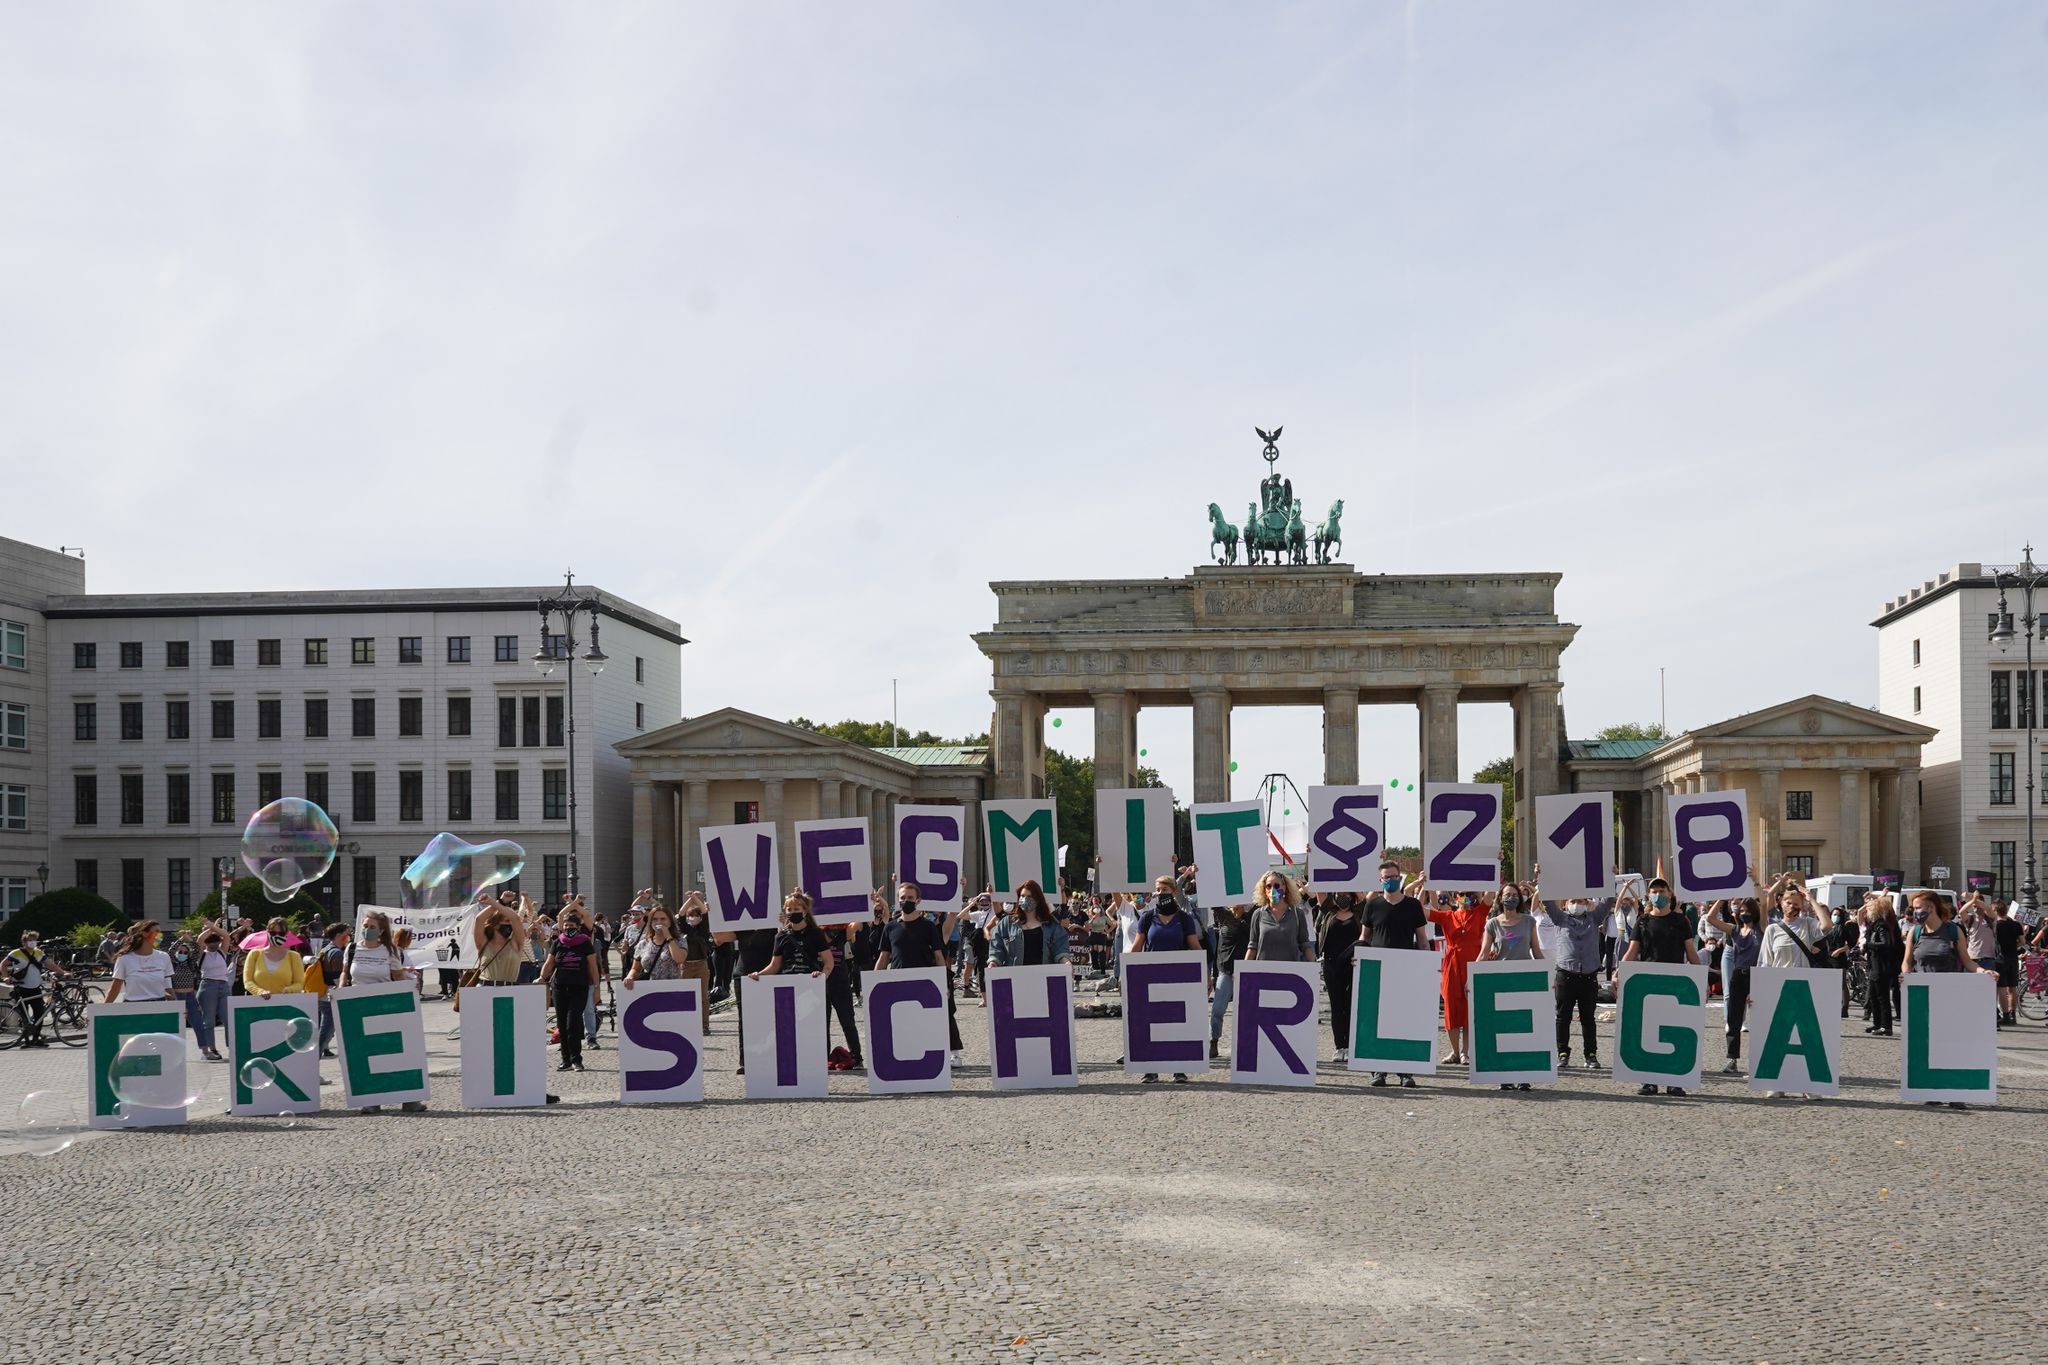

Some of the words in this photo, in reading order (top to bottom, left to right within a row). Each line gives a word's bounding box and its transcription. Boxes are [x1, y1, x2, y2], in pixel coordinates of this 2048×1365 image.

[706, 814, 959, 922] WEG
[988, 795, 1260, 895] MIT
[94, 992, 514, 1115] FREI
[624, 963, 1314, 1090] SICHER
[1354, 960, 1990, 1090] LEGAL
